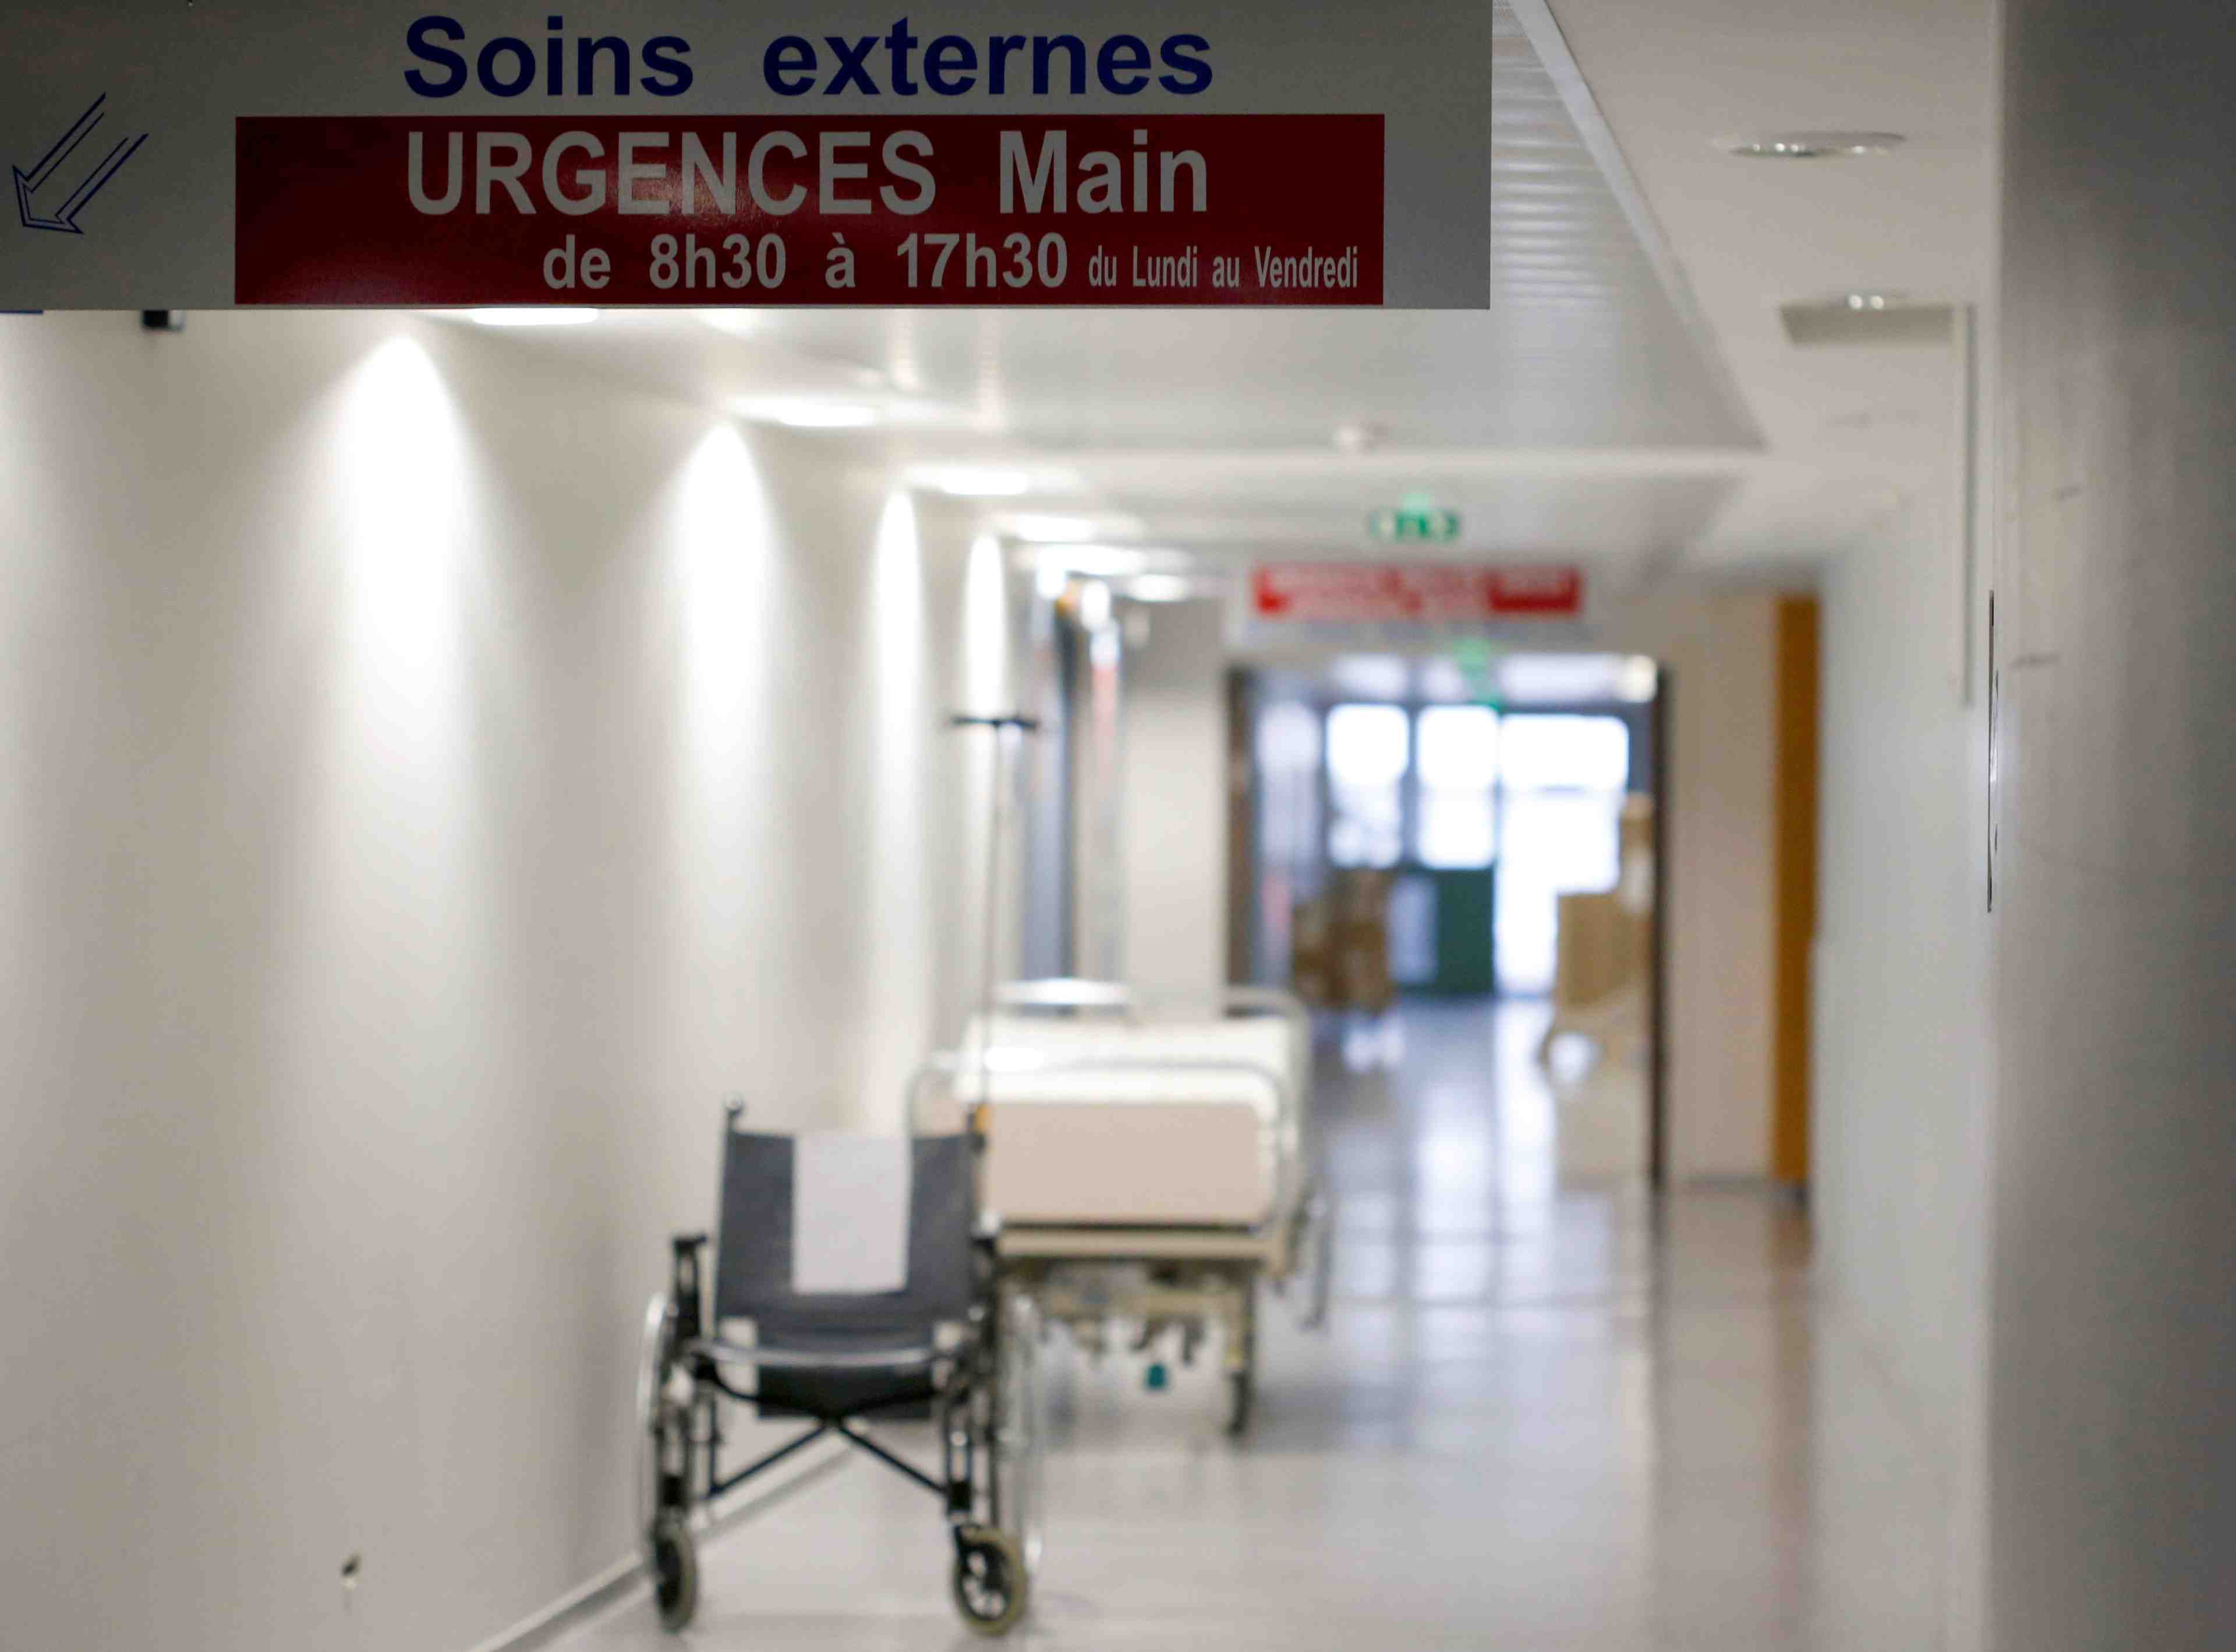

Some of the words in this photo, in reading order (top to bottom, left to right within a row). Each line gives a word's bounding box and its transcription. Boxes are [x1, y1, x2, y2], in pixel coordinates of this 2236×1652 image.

[404, 16, 692, 98] Soins
[763, 17, 1213, 96] externes
[408, 130, 936, 215] URGENCES
[1000, 129, 1207, 214] Main
[543, 234, 611, 289] de
[649, 233, 786, 289] 8h30
[825, 233, 855, 289] à
[897, 232, 1067, 288] 17h30
[1088, 245, 1117, 288] du
[1133, 245, 1198, 288] Lundi
[1212, 256, 1240, 288] au
[1254, 246, 1357, 288] Vendredi
